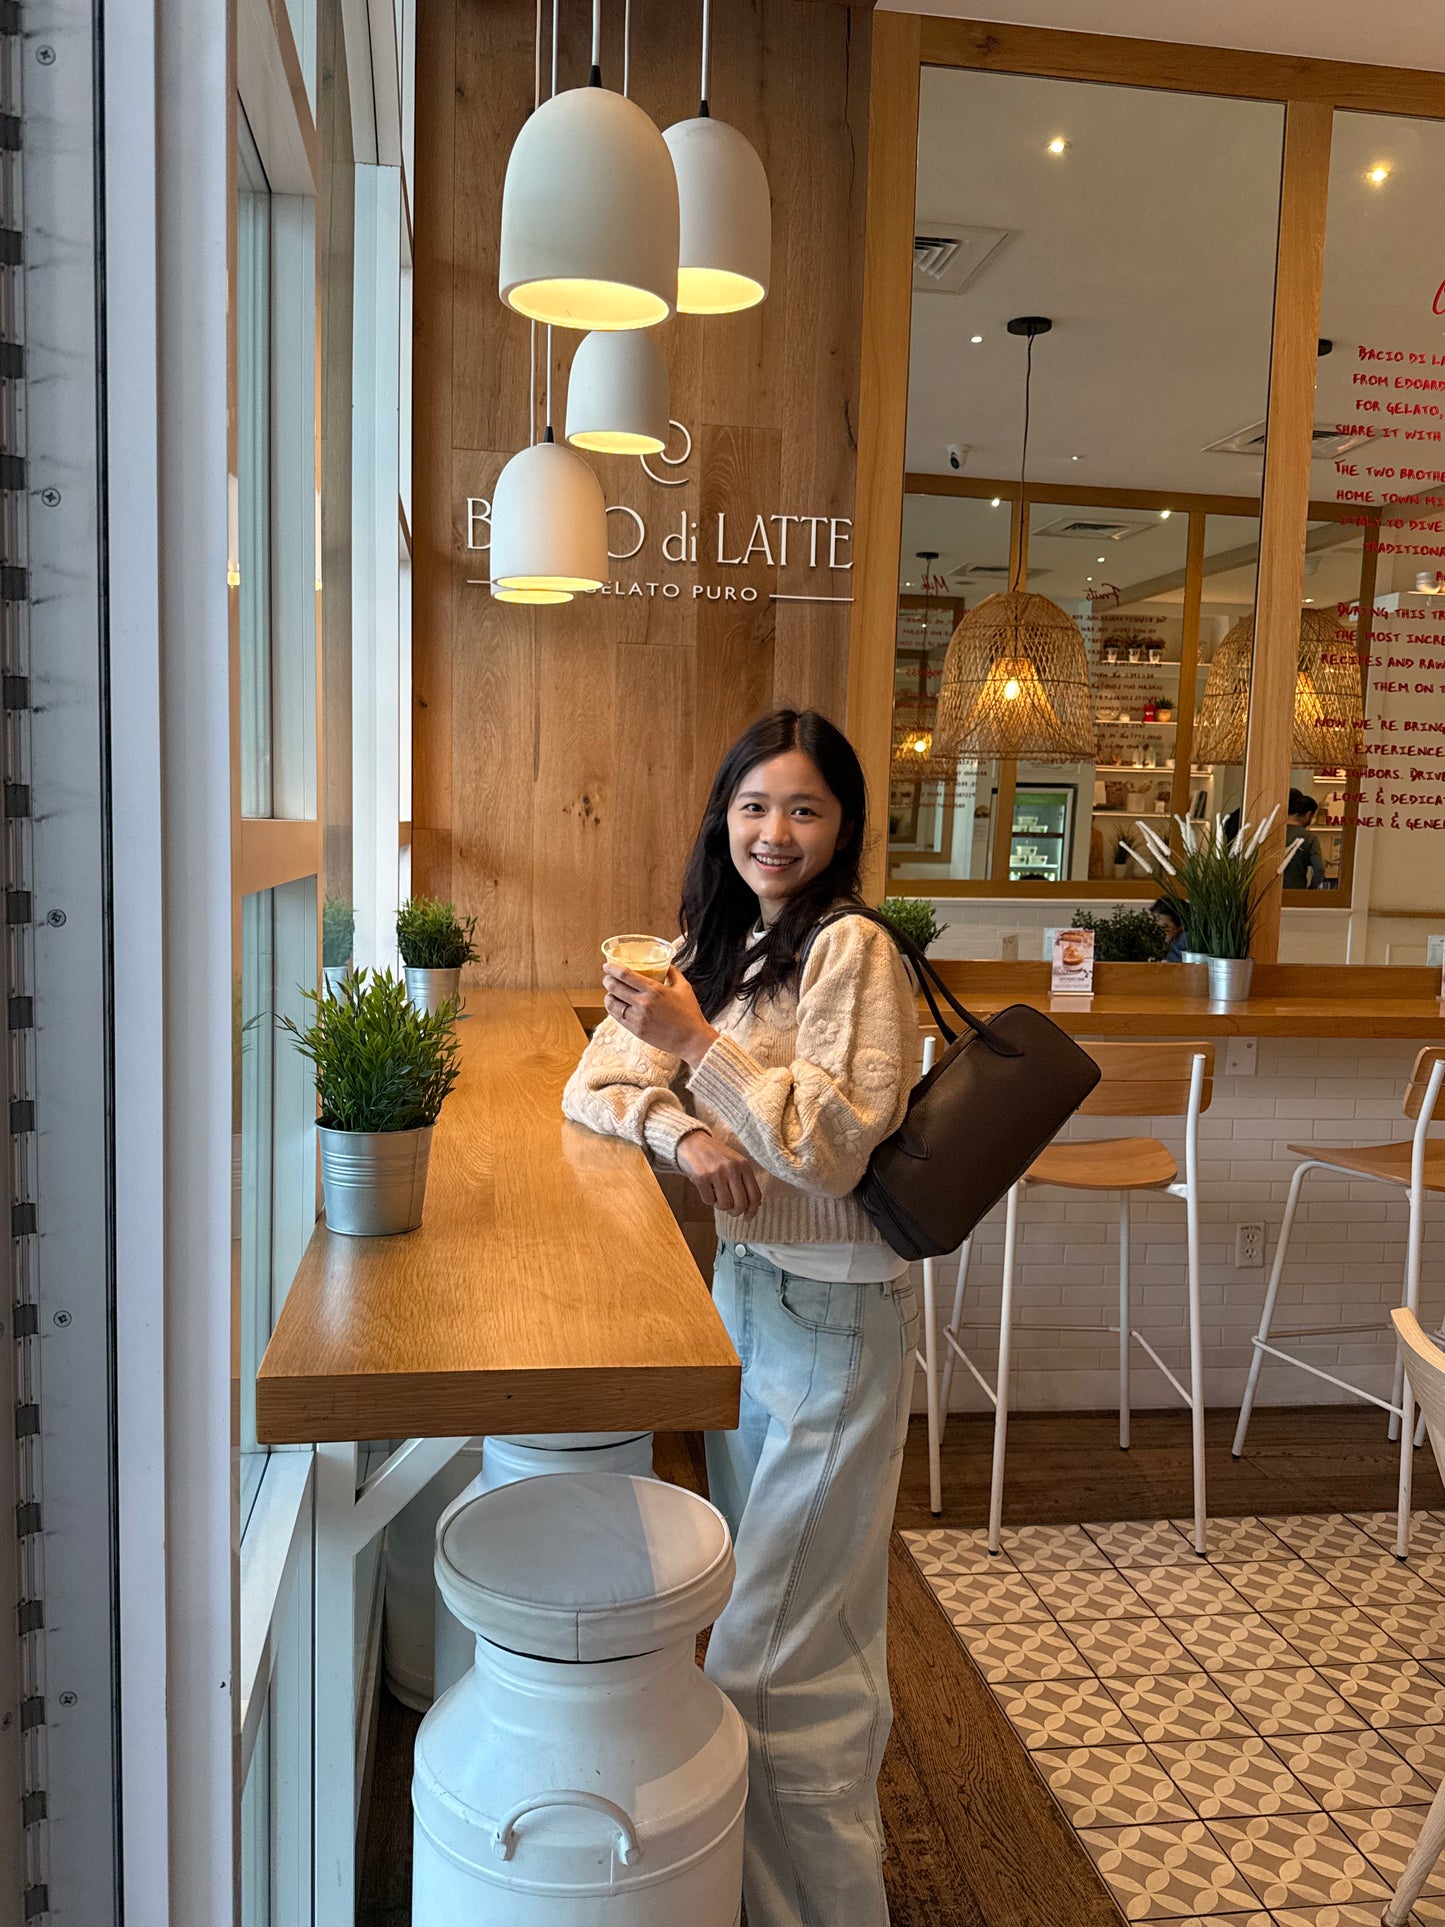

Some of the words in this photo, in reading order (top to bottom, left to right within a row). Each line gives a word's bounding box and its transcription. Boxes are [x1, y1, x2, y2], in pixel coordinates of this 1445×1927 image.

[1358, 345, 1404, 362] BACIO
[1409, 351, 1426, 364] DI
[1353, 373, 1389, 388] FROM
[1356, 399, 1380, 412] FOR
[1386, 401, 1444, 420] GELATO,
[1335, 423, 1376, 438] SHARE
[1382, 427, 1400, 439] IT
[1405, 430, 1442, 442] WITH
[1334, 459, 1360, 477] THE
[1366, 466, 1396, 478] TWO
[1336, 489, 1376, 503] HOME
[1382, 492, 1421, 505] TOWN
[1340, 514, 1382, 528] ITALY
[1387, 518, 1405, 530] TO
[1409, 520, 1444, 533] DIVE
[661, 510, 698, 562] di
[717, 512, 854, 569] LATTE
[584, 581, 681, 599] ELATO
[692, 584, 758, 601] PURO
[1337, 602, 1388, 620] DURING
[1394, 608, 1426, 620] THIS
[1334, 629, 1358, 641] THE
[1365, 631, 1401, 643] MOST
[1320, 653, 1383, 668] RECIPES
[1387, 656, 1415, 669] AND
[1373, 682, 1409, 694] THEM
[1414, 684, 1434, 694] ON
[1314, 717, 1346, 729] NOW
[1354, 744, 1445, 757] EXPERIENCE
[1333, 791, 1368, 803] LOVE
[1376, 786, 1384, 805] &
[1391, 793, 1445, 805] DEDICA
[1325, 815, 1384, 827] PARTNER
[1391, 811, 1400, 829] &
[1406, 818, 1445, 830] GENE
